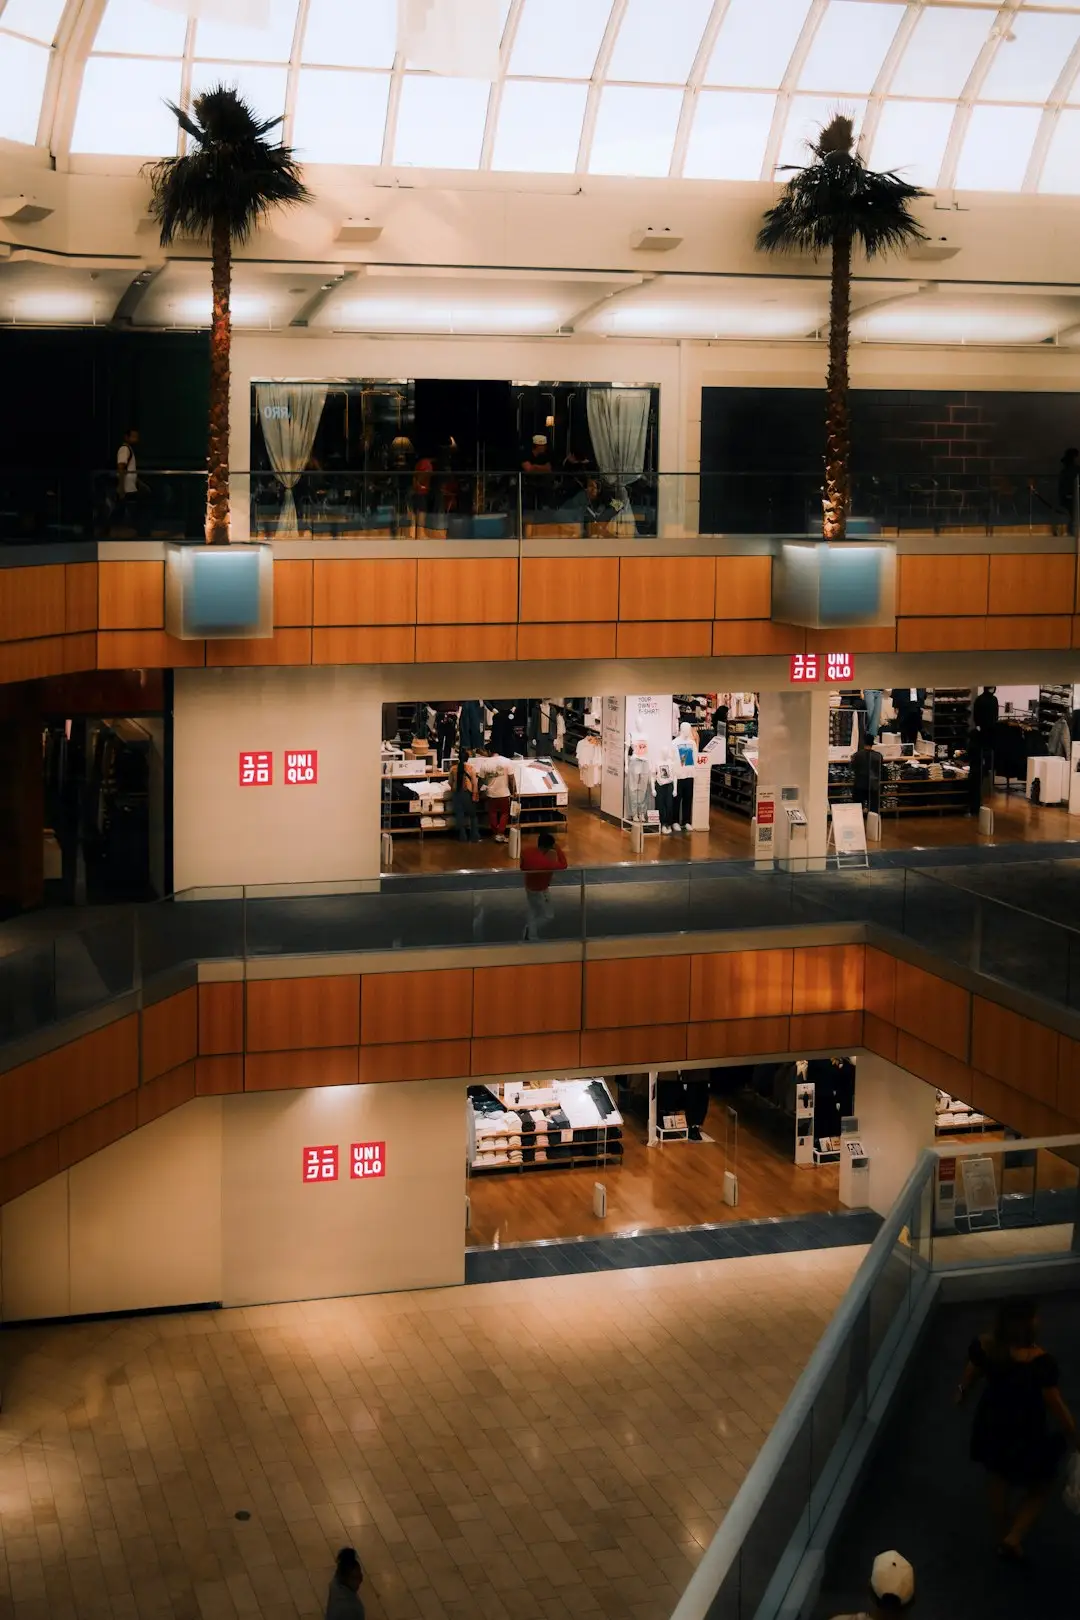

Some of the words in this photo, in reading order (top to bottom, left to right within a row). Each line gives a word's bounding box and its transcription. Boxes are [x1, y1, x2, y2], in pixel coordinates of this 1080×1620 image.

[827, 653, 849, 665] UNI
[827, 666, 851, 680] QLO
[243, 755, 268, 769] ユニ
[287, 753, 312, 767] UNI
[242, 769, 269, 783] クロ
[287, 767, 314, 783] QLO
[308, 1149, 334, 1164] ユニ
[353, 1146, 379, 1161] UNI
[306, 1164, 334, 1179] クロ
[353, 1160, 382, 1177] QLO
